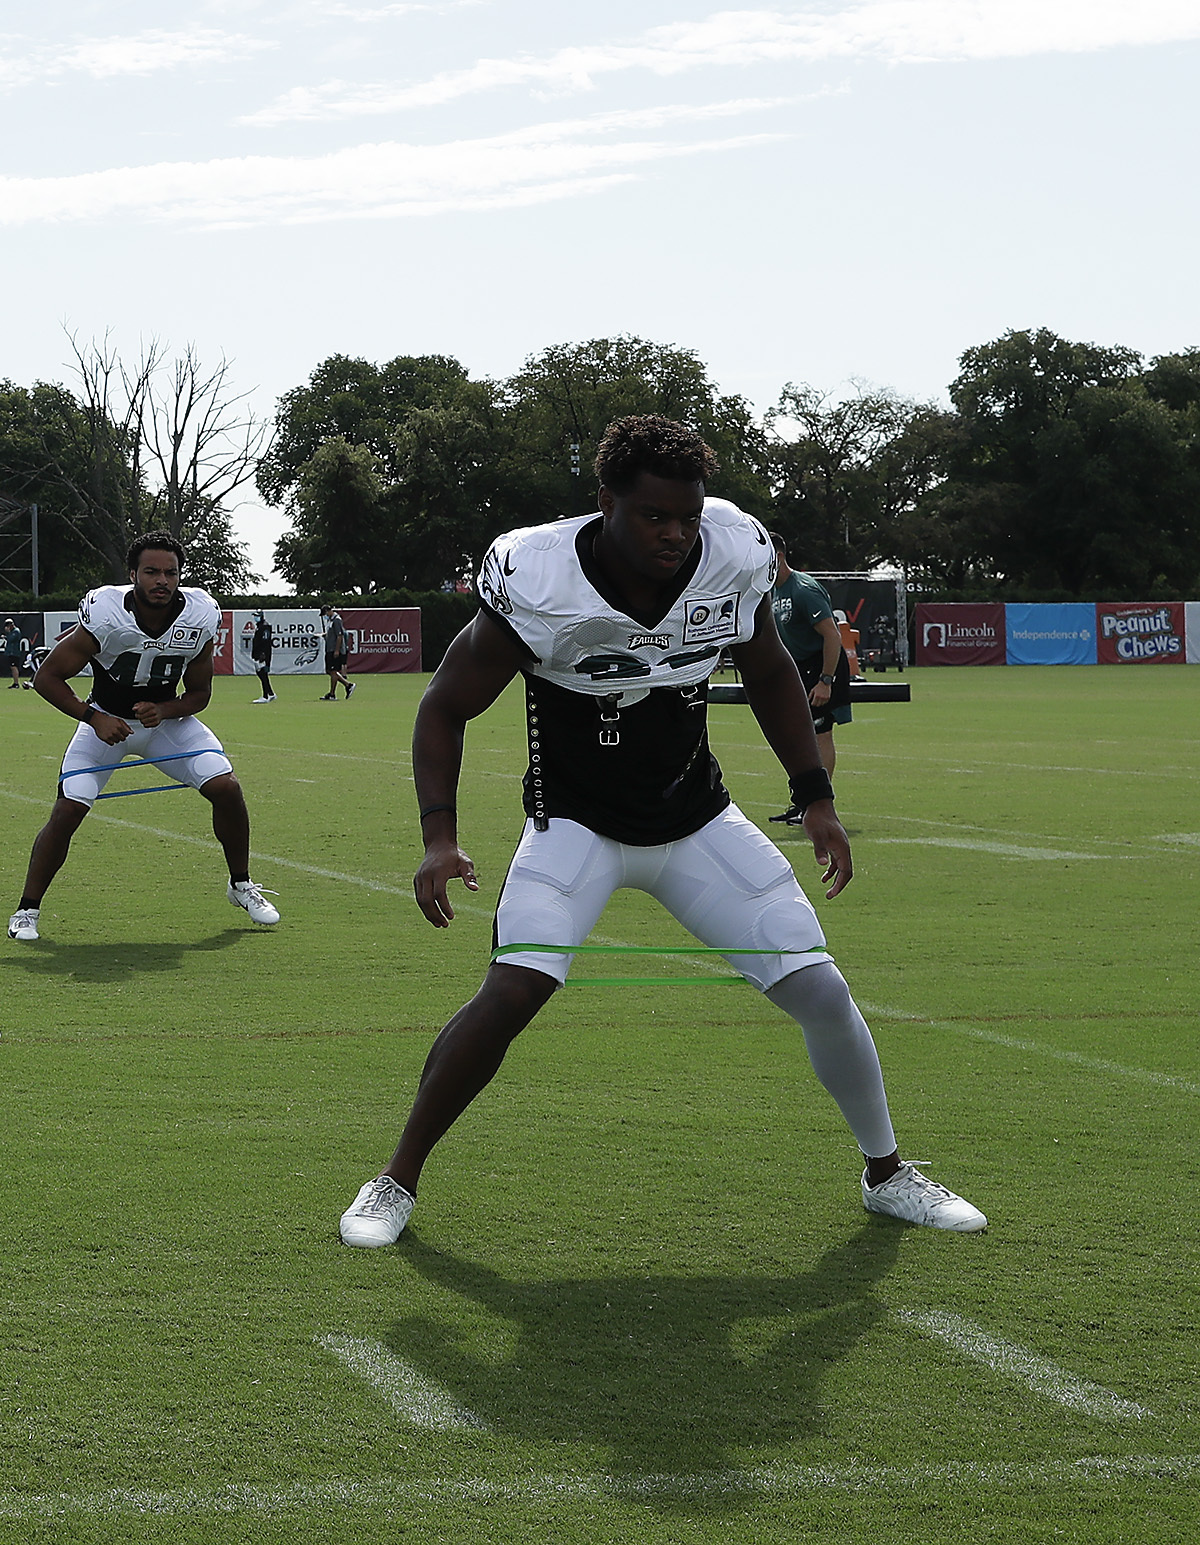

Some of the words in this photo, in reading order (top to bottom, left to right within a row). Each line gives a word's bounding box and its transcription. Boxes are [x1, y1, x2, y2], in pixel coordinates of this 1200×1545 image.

[270, 624, 315, 634] LL-PRO
[947, 622, 995, 637] Lincoln
[1102, 610, 1170, 636] Peanut
[242, 637, 318, 649] TCHERS
[360, 628, 410, 643] Lincoln
[628, 634, 673, 650] EAGLES
[1013, 630, 1078, 641] Independence
[1117, 635, 1180, 657] Chews
